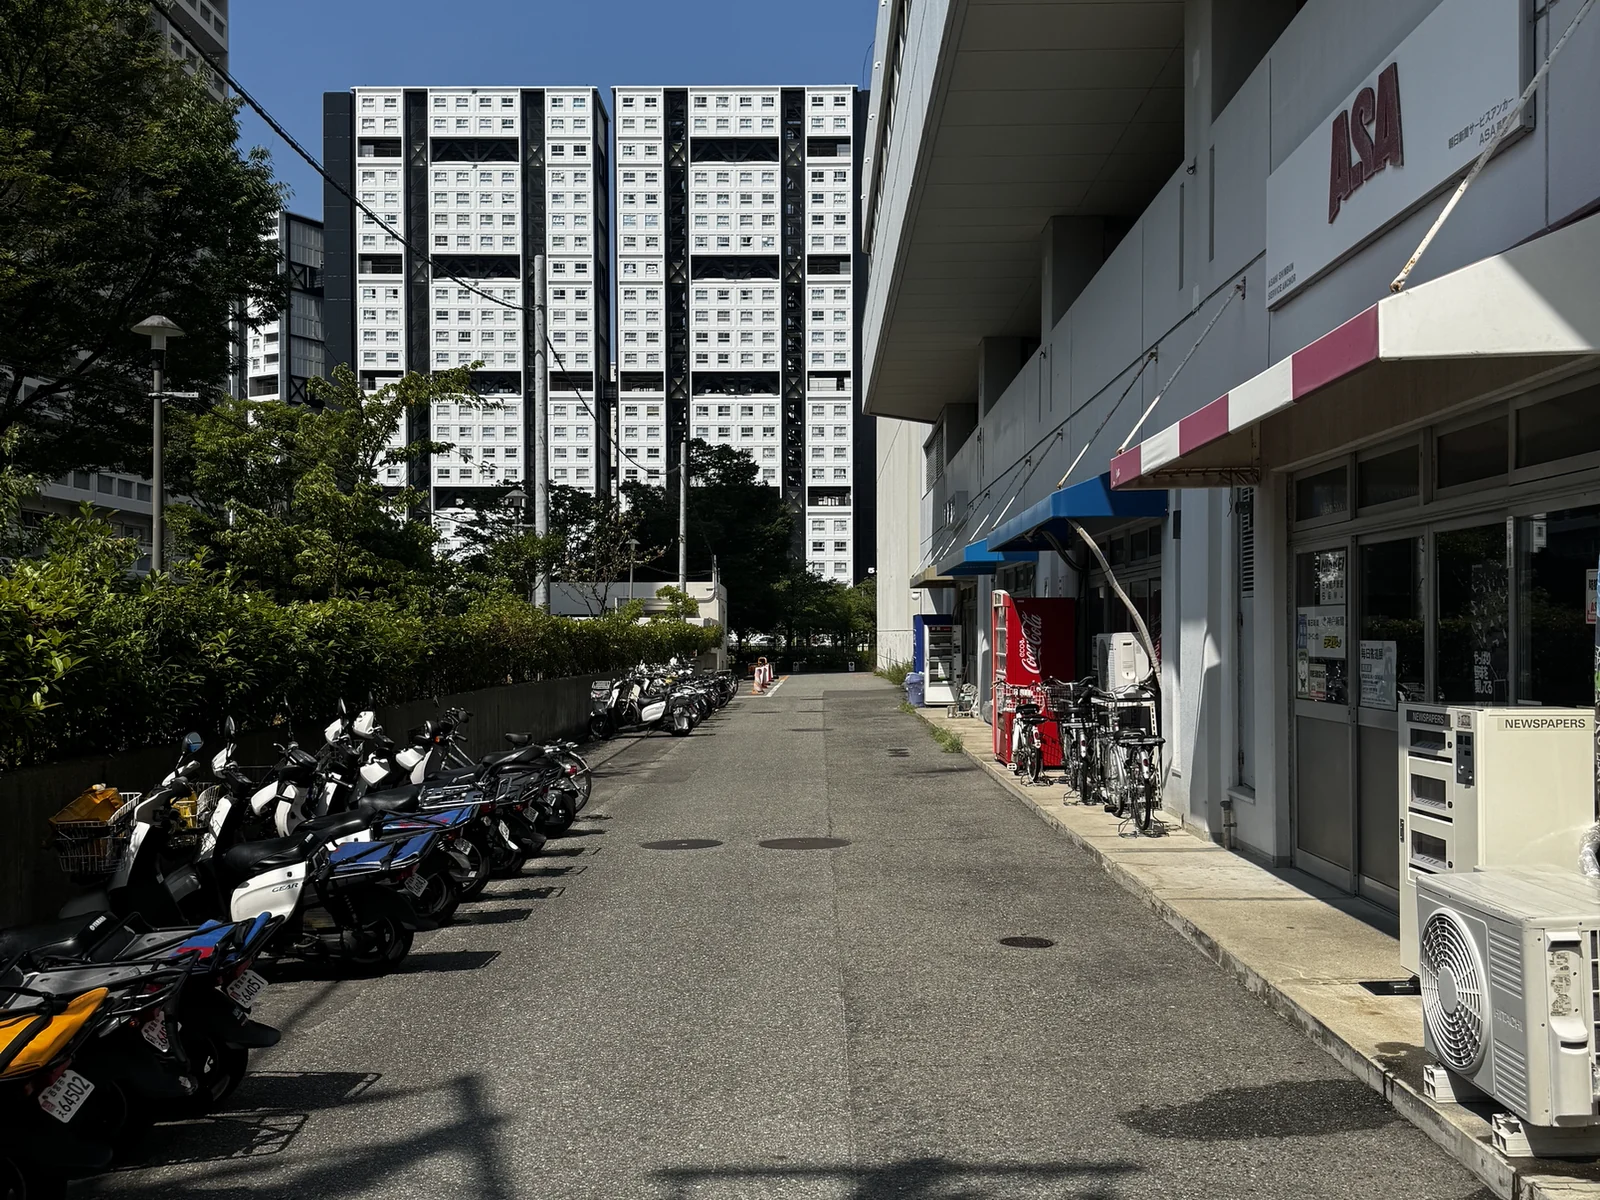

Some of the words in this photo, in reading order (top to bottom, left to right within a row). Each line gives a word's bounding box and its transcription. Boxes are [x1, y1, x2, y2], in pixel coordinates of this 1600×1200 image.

[1328, 62, 1404, 224] ASA
[1268, 284, 1282, 300] SERVICE
[1282, 274, 1296, 290] ANCHOR
[1412, 712, 1444, 724] NEWSPAPERS
[1505, 719, 1586, 729] NEWSPAPERS
[272, 882, 299, 893] GEAR
[242, 975, 264, 1000] 64051
[1494, 1008, 1523, 1032] HITACHI
[59, 1076, 90, 1112] 64502
